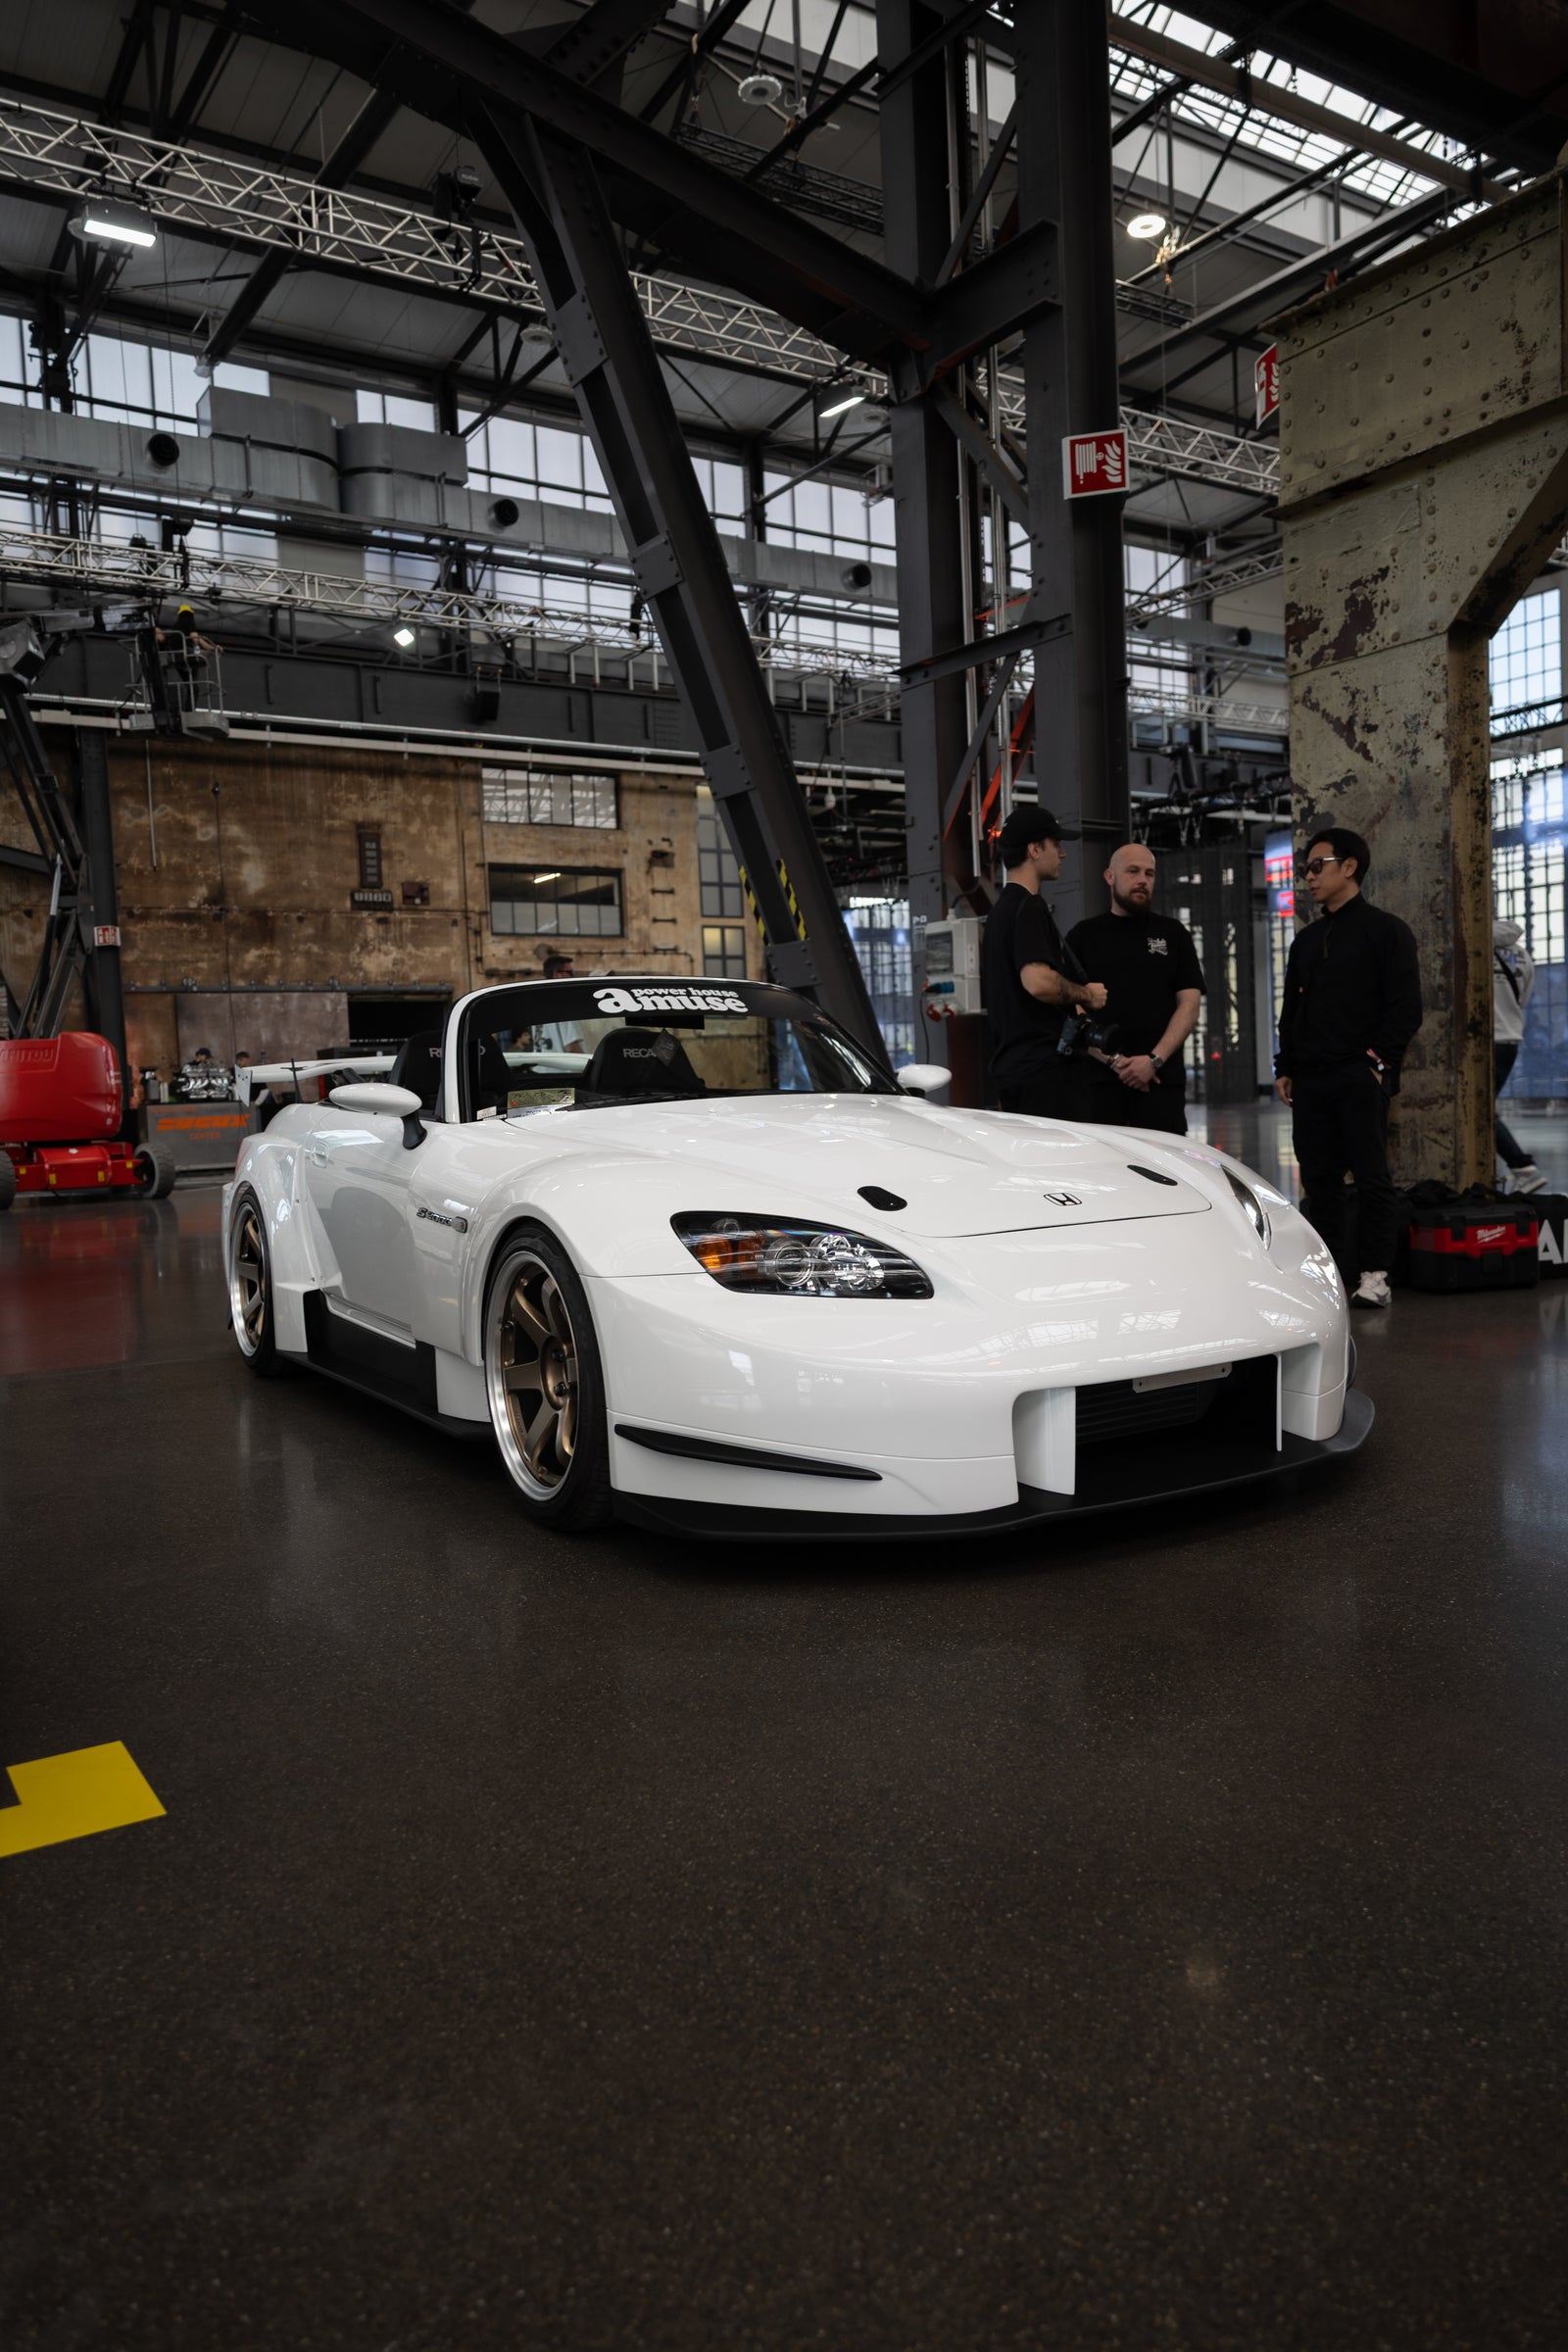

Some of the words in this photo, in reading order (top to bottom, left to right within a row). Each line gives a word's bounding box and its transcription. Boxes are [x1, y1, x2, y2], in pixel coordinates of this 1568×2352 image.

[630, 988, 687, 997] power
[688, 987, 739, 998] house
[593, 988, 749, 1013] amuse
[622, 1048, 658, 1058] RECA
